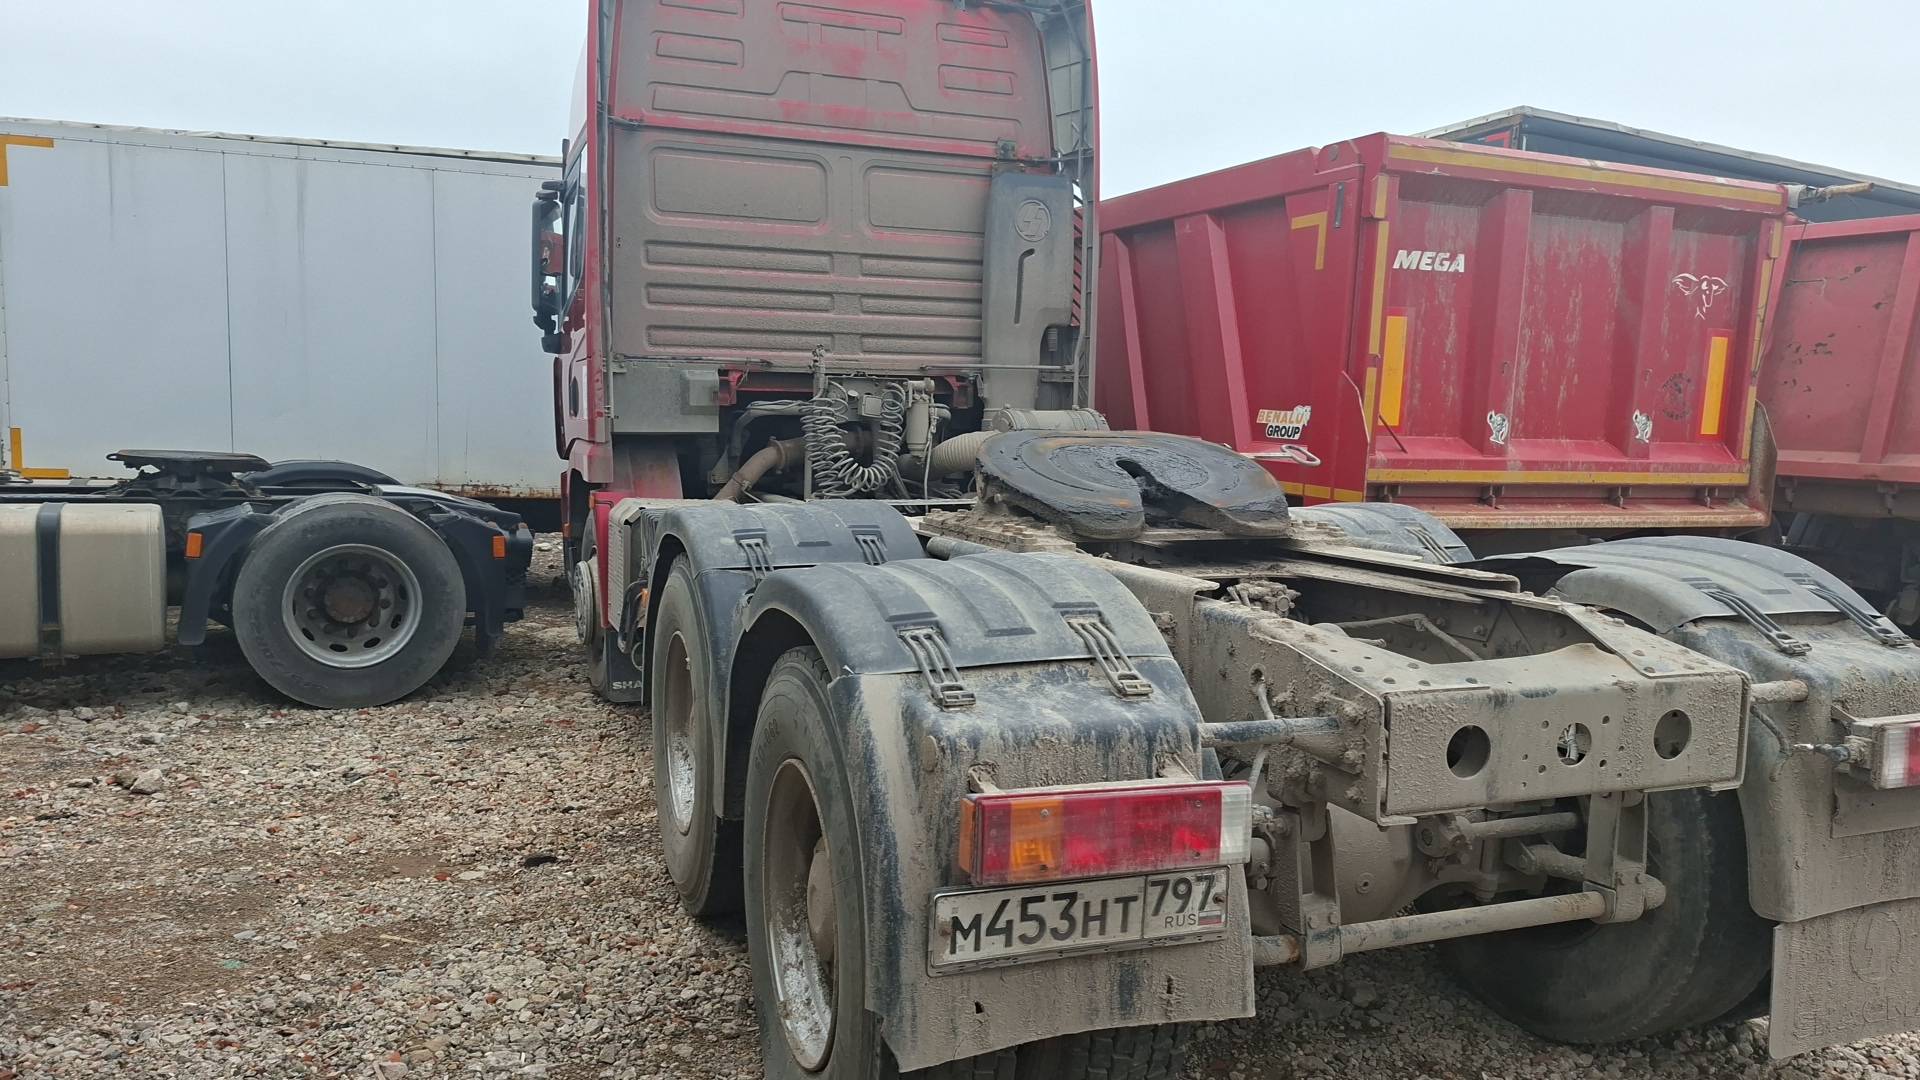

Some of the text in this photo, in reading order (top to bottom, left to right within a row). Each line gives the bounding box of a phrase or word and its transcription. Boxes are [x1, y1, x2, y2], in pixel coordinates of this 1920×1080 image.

[1392, 249, 1465, 273] MEGA
[1257, 410, 1305, 424] BENALU
[1266, 425, 1300, 438] GROUP
[1150, 875, 1216, 917] 797
[1164, 913, 1197, 928] RUS
